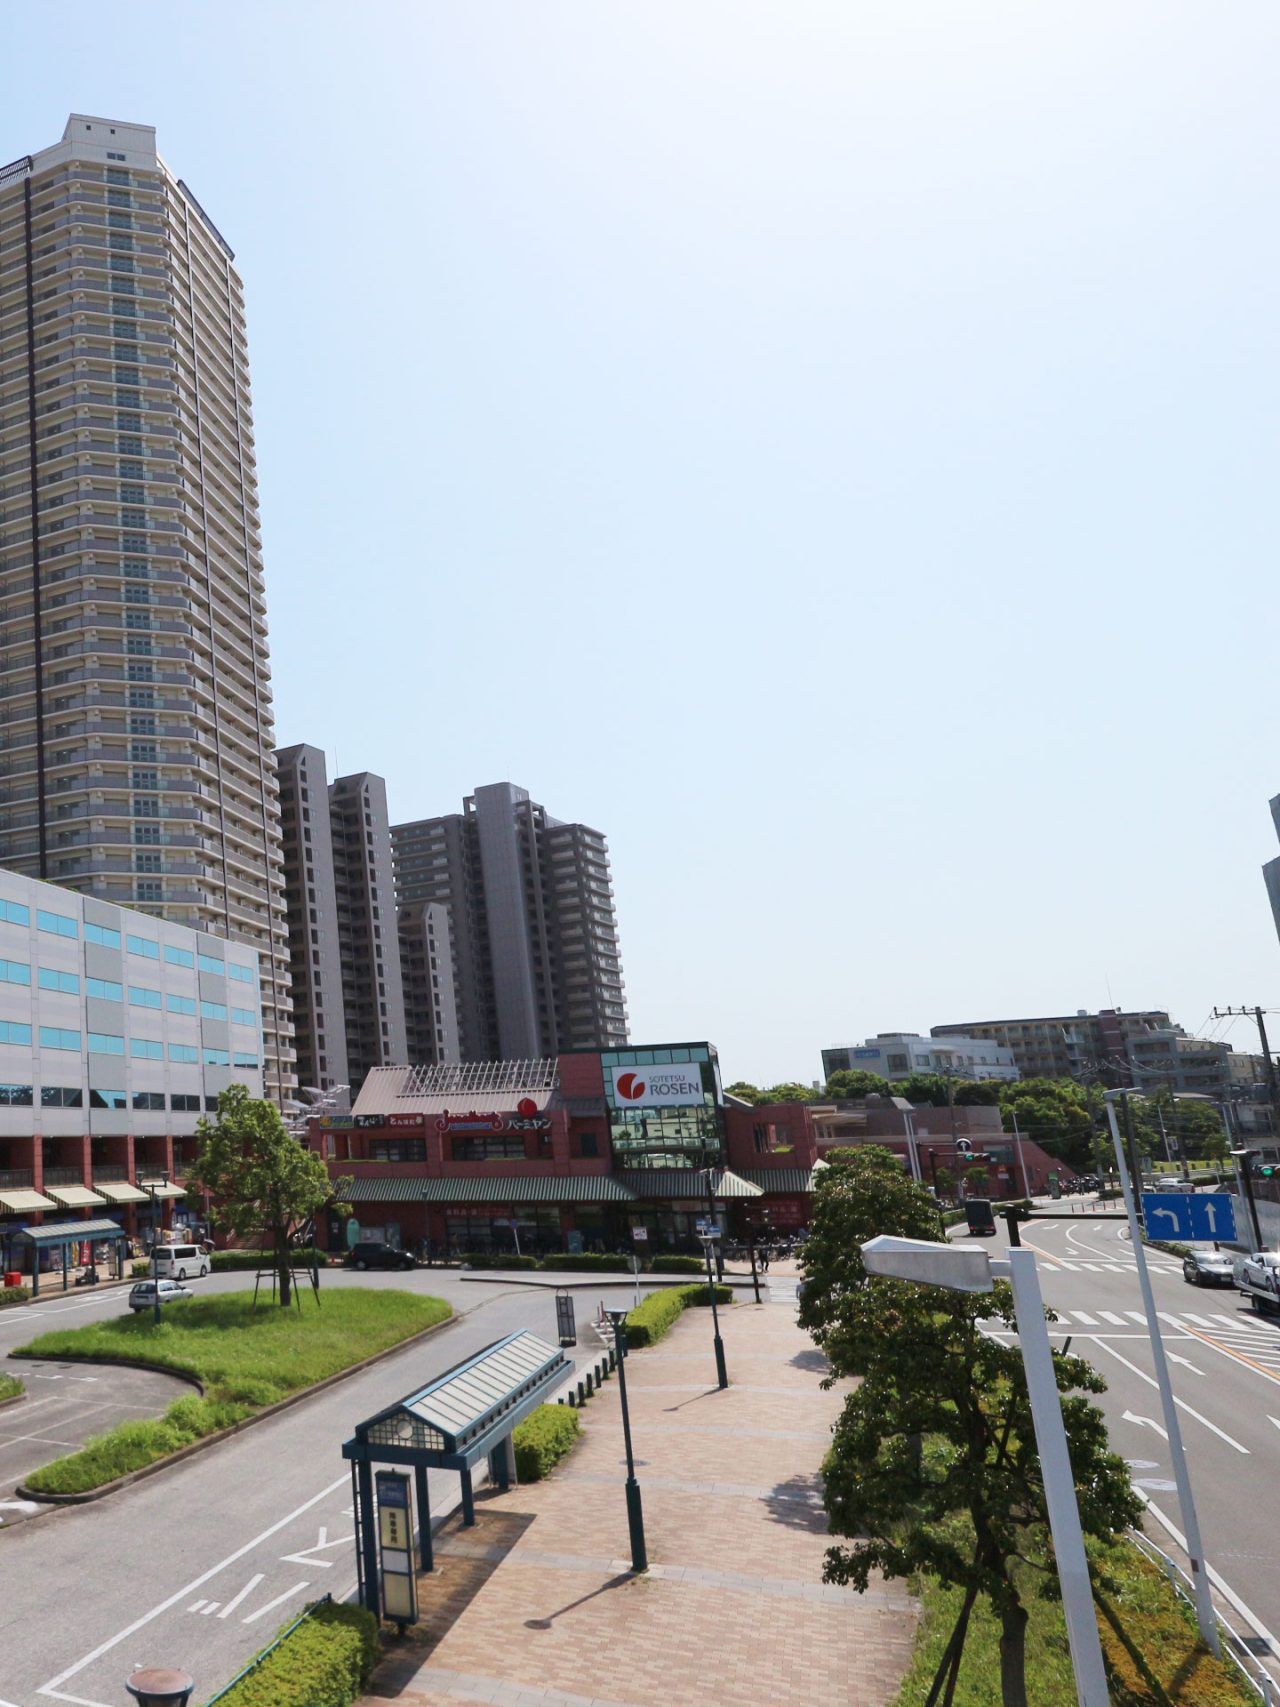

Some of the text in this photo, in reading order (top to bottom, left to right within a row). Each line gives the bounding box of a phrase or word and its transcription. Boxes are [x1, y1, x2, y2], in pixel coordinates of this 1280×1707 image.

[649, 1075, 685, 1083] SOTETSU
[650, 1083, 700, 1095] ROSEN
[507, 1118, 552, 1130] バーミヤン
